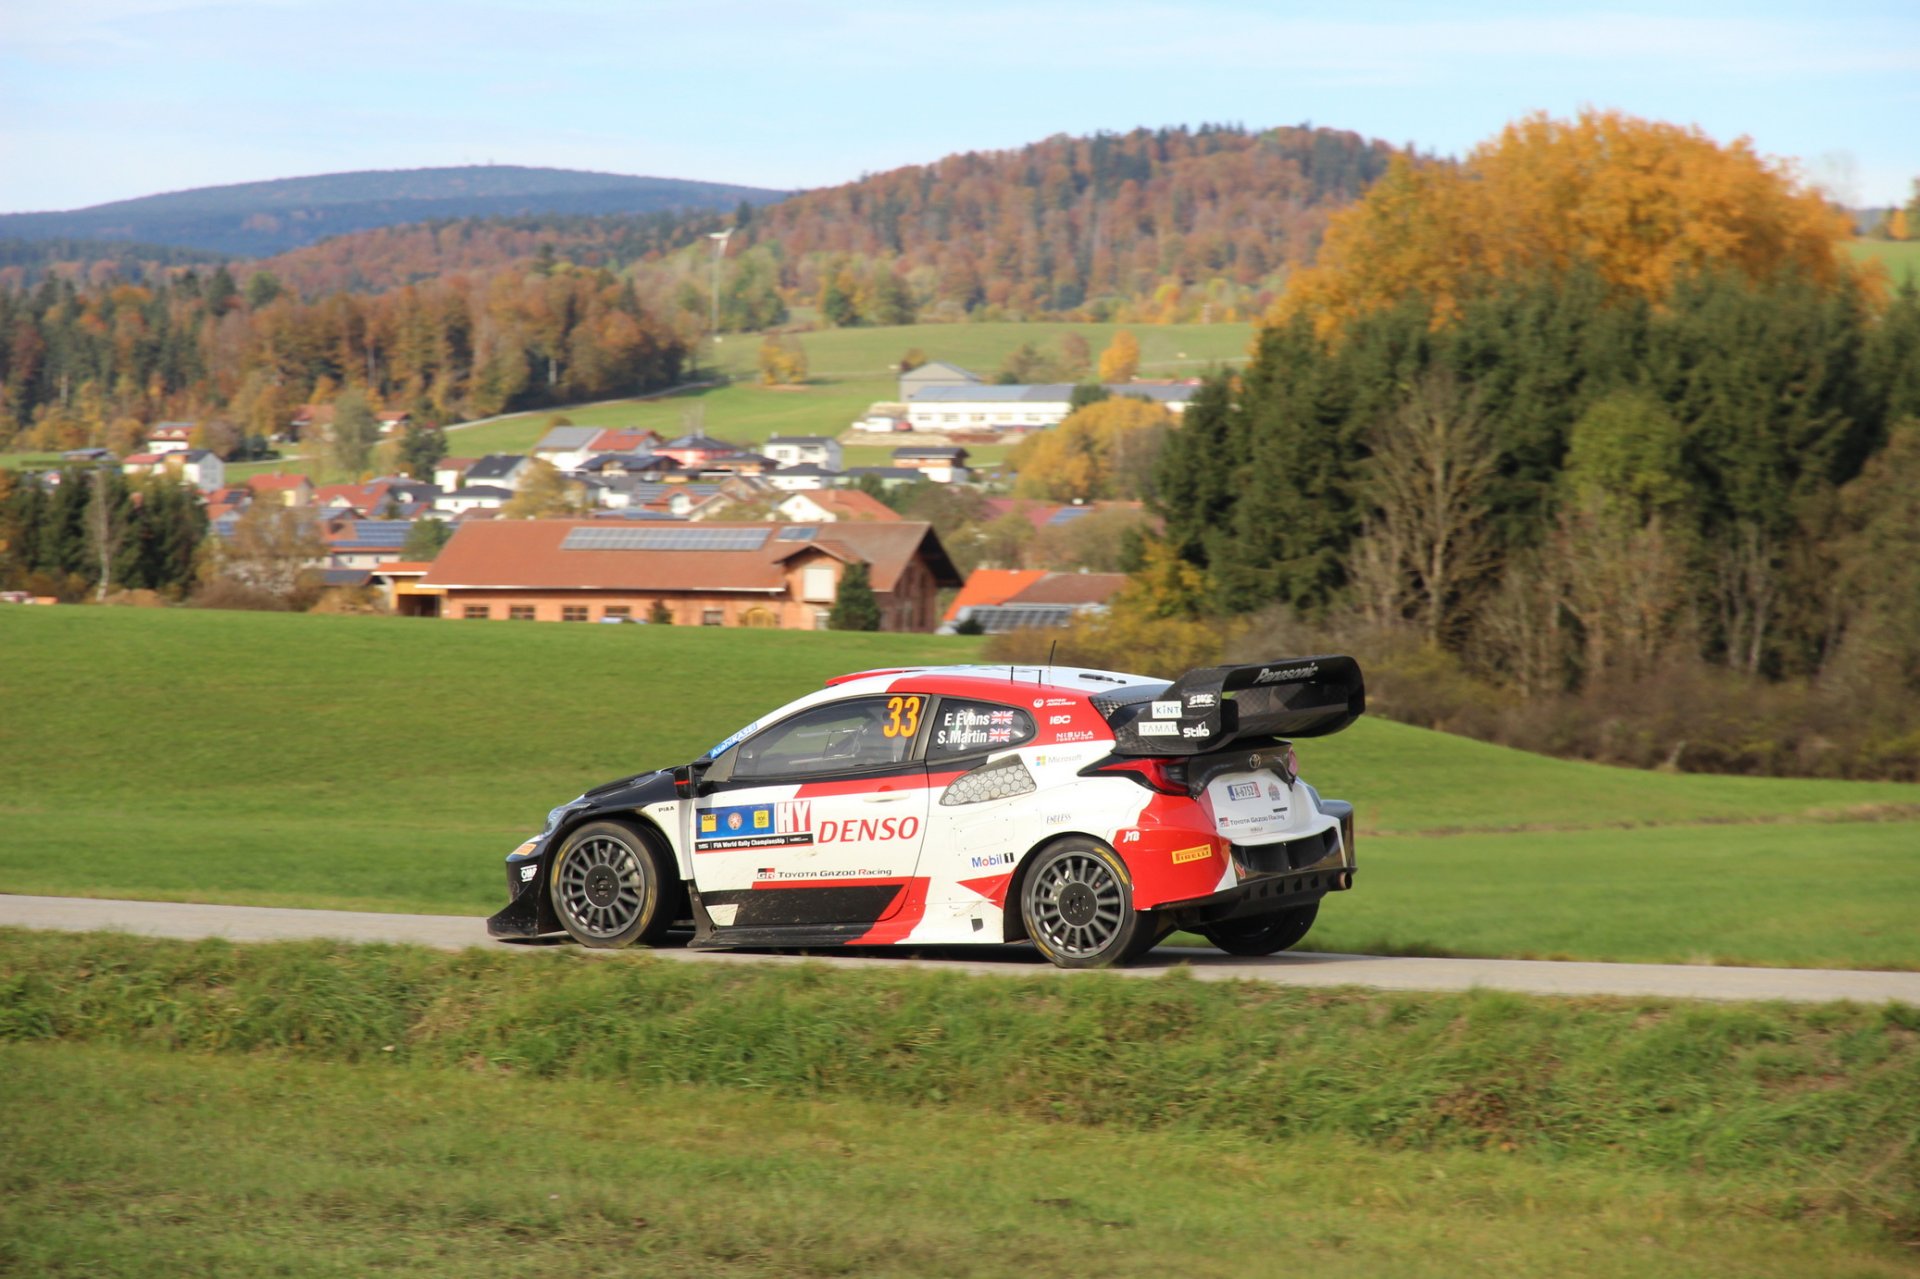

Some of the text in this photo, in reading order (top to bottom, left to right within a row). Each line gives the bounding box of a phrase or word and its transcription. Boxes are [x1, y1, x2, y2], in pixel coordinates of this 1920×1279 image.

[1252, 662, 1319, 684] Panasonic
[883, 696, 920, 738] 33
[1156, 706, 1182, 714] KINT
[944, 712, 990, 726] E.Evans
[937, 729, 988, 744] S.Martin
[1183, 721, 1210, 738] Stilo
[1048, 754, 1082, 764] Microsoft
[777, 801, 811, 833] HY
[818, 816, 919, 843] DENSO
[738, 840, 750, 848] Rally
[751, 838, 785, 846] Championship
[971, 853, 1002, 868] Mobil
[778, 871, 817, 879] TOYOTA
[858, 868, 892, 876] Racing
